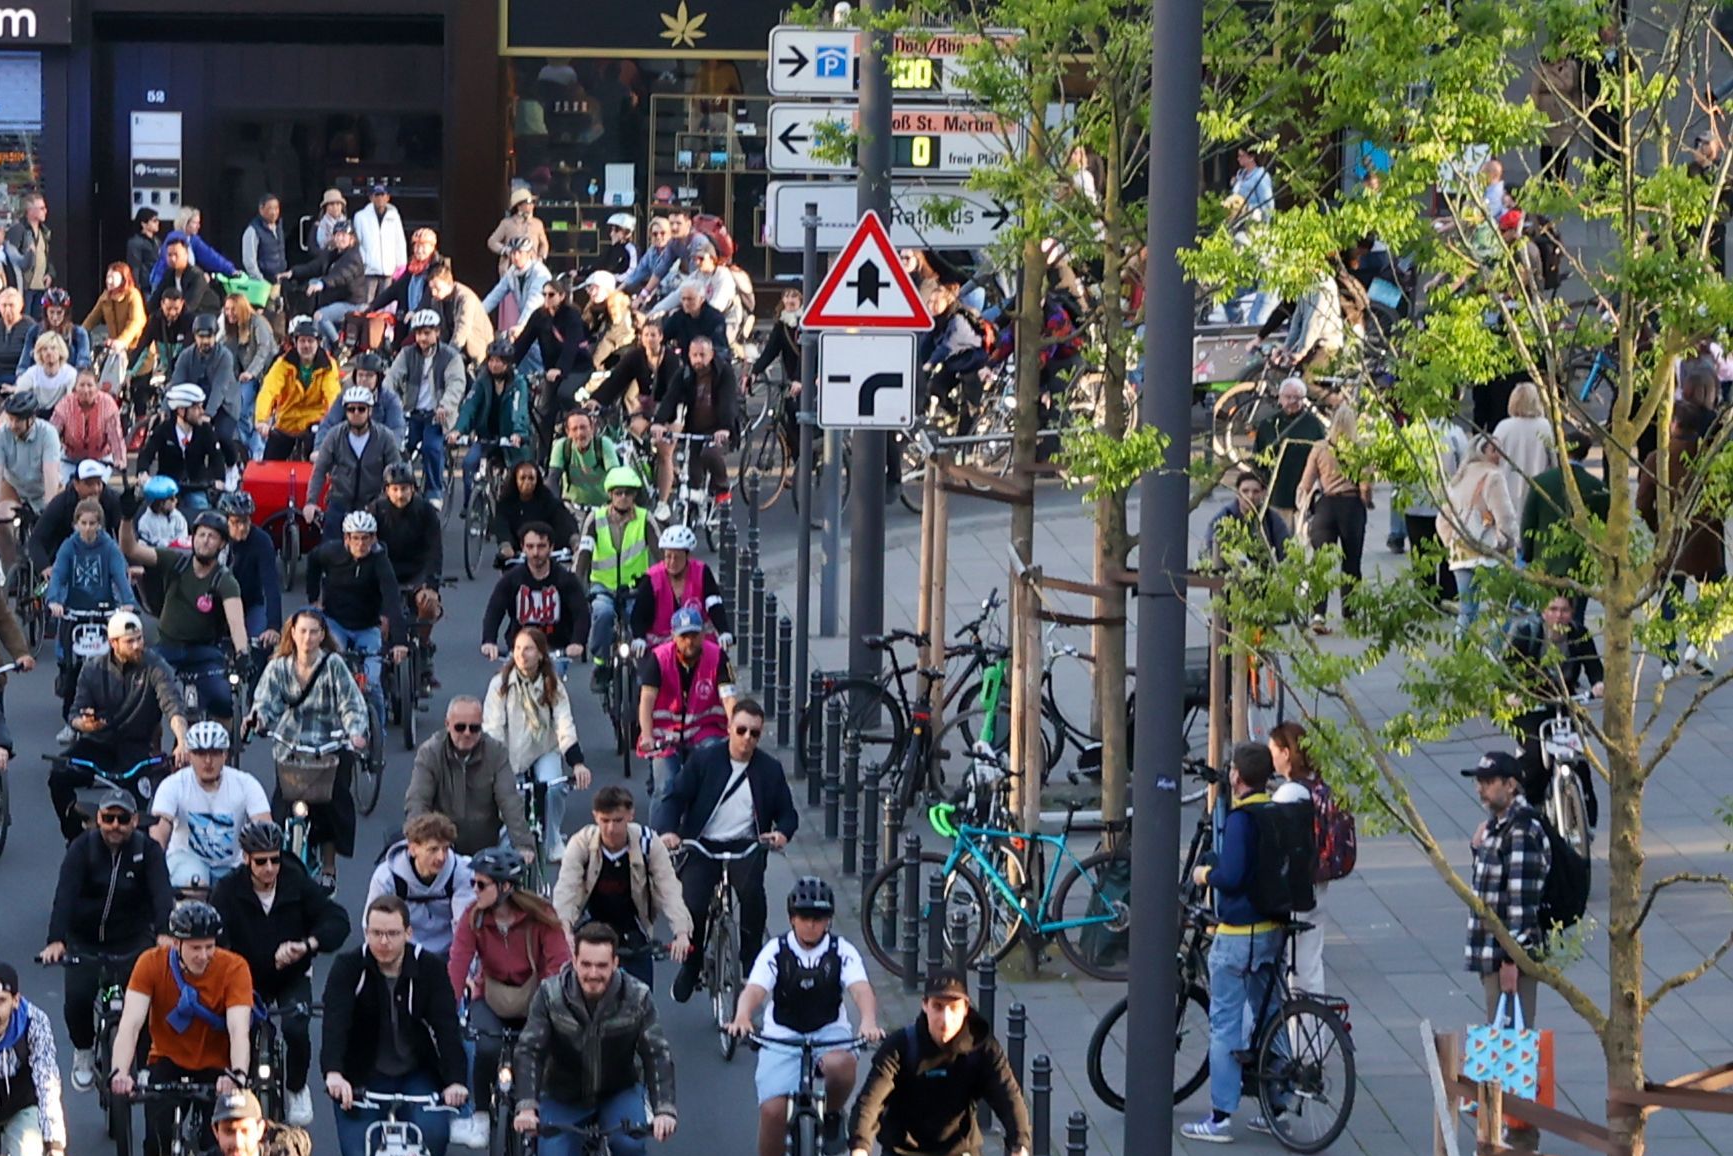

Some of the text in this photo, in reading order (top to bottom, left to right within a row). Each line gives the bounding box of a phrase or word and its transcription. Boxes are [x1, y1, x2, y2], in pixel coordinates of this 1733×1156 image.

[147, 90, 165, 103] 52
[917, 114, 937, 131] St.
[944, 115, 993, 132] Martin
[912, 136, 931, 166] 0
[948, 152, 973, 164] freie
[517, 585, 559, 624] Duff
